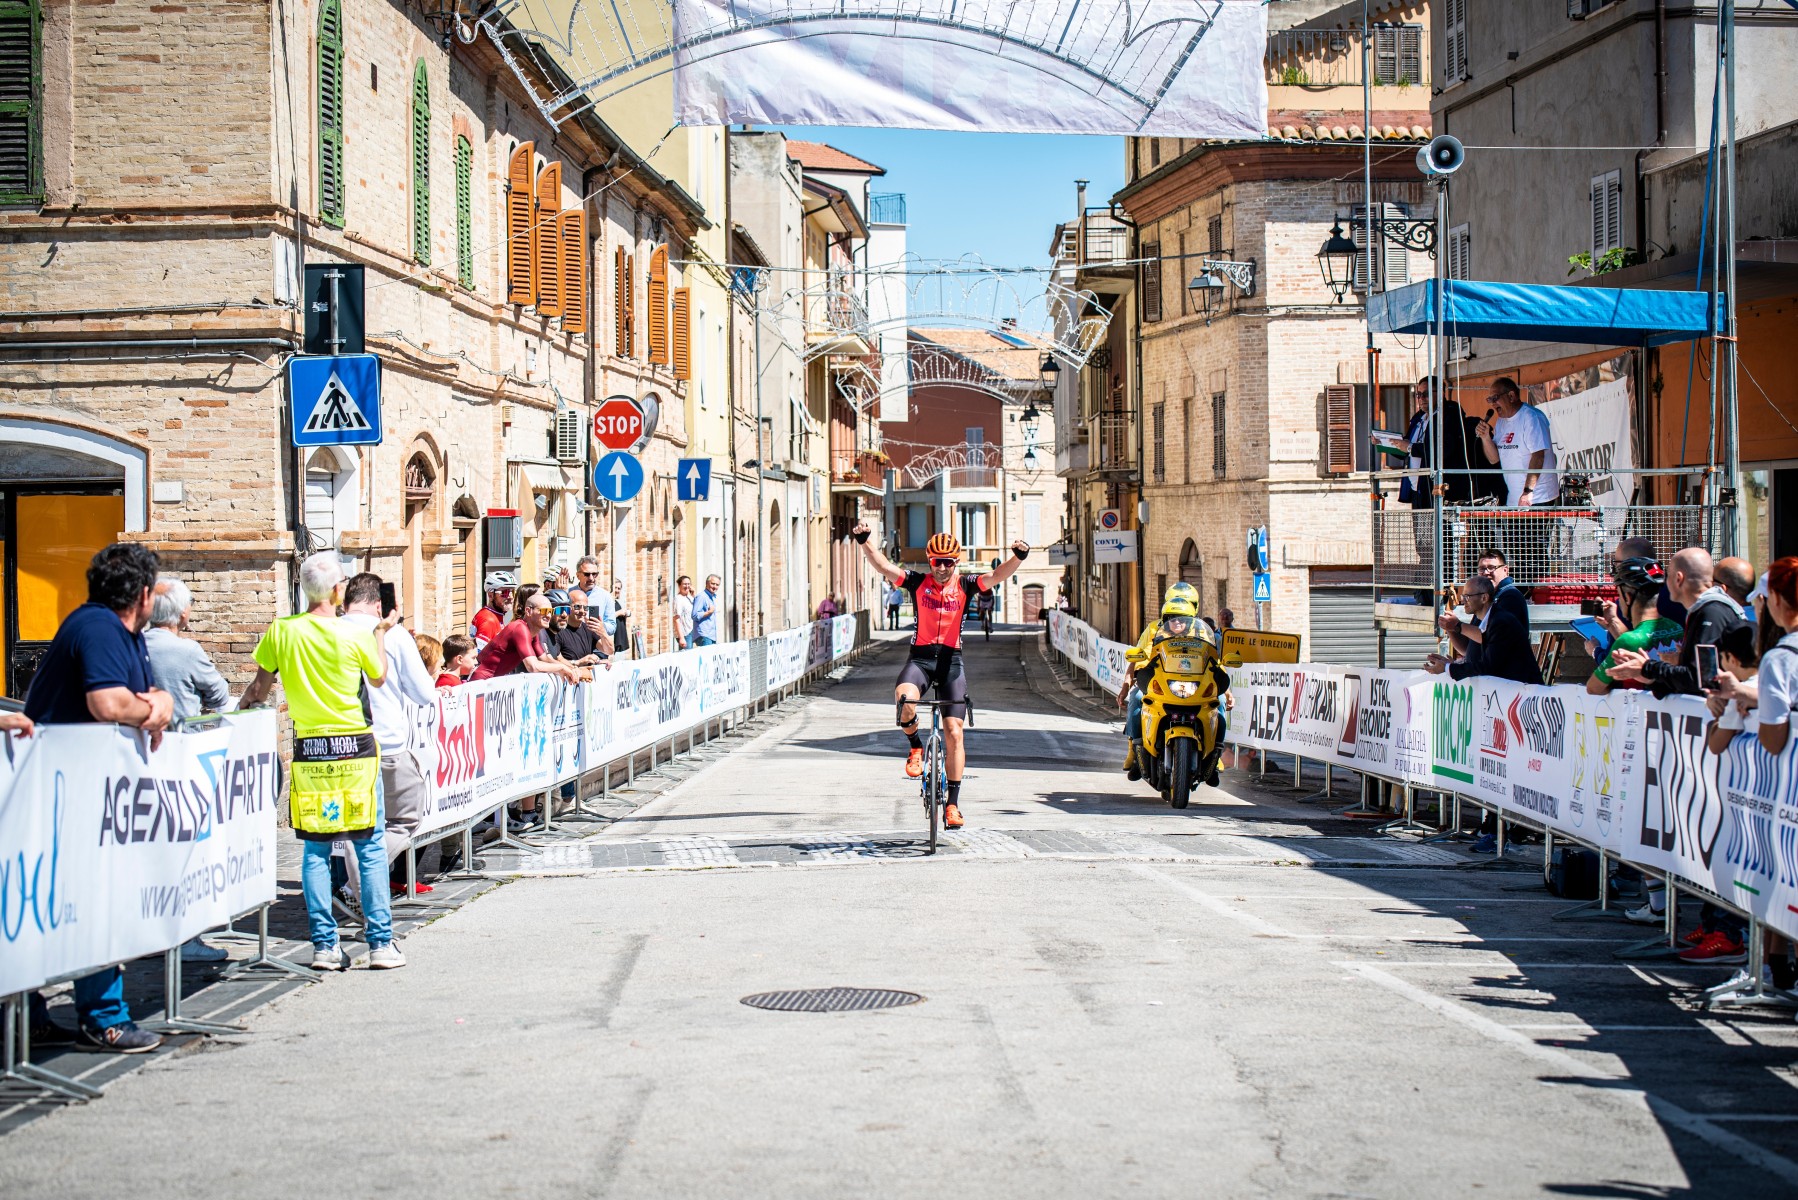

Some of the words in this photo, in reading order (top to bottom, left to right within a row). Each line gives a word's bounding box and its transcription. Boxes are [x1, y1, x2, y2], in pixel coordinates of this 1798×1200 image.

[597, 416, 639, 434] STOP
[1095, 538, 1119, 546] CONTI
[1227, 636, 1245, 645] TUTTE
[1249, 638, 1256, 646] LE
[1260, 640, 1296, 650] DIREZIONI
[1248, 694, 1289, 742] ALEX
[1359, 708, 1392, 740] GRONDE
[1432, 682, 1474, 767] MACAP
[302, 738, 328, 756] STUDIO
[329, 736, 359, 754] MODA
[1727, 791, 1758, 810] DESIGNER
[1758, 803, 1774, 815] PER
